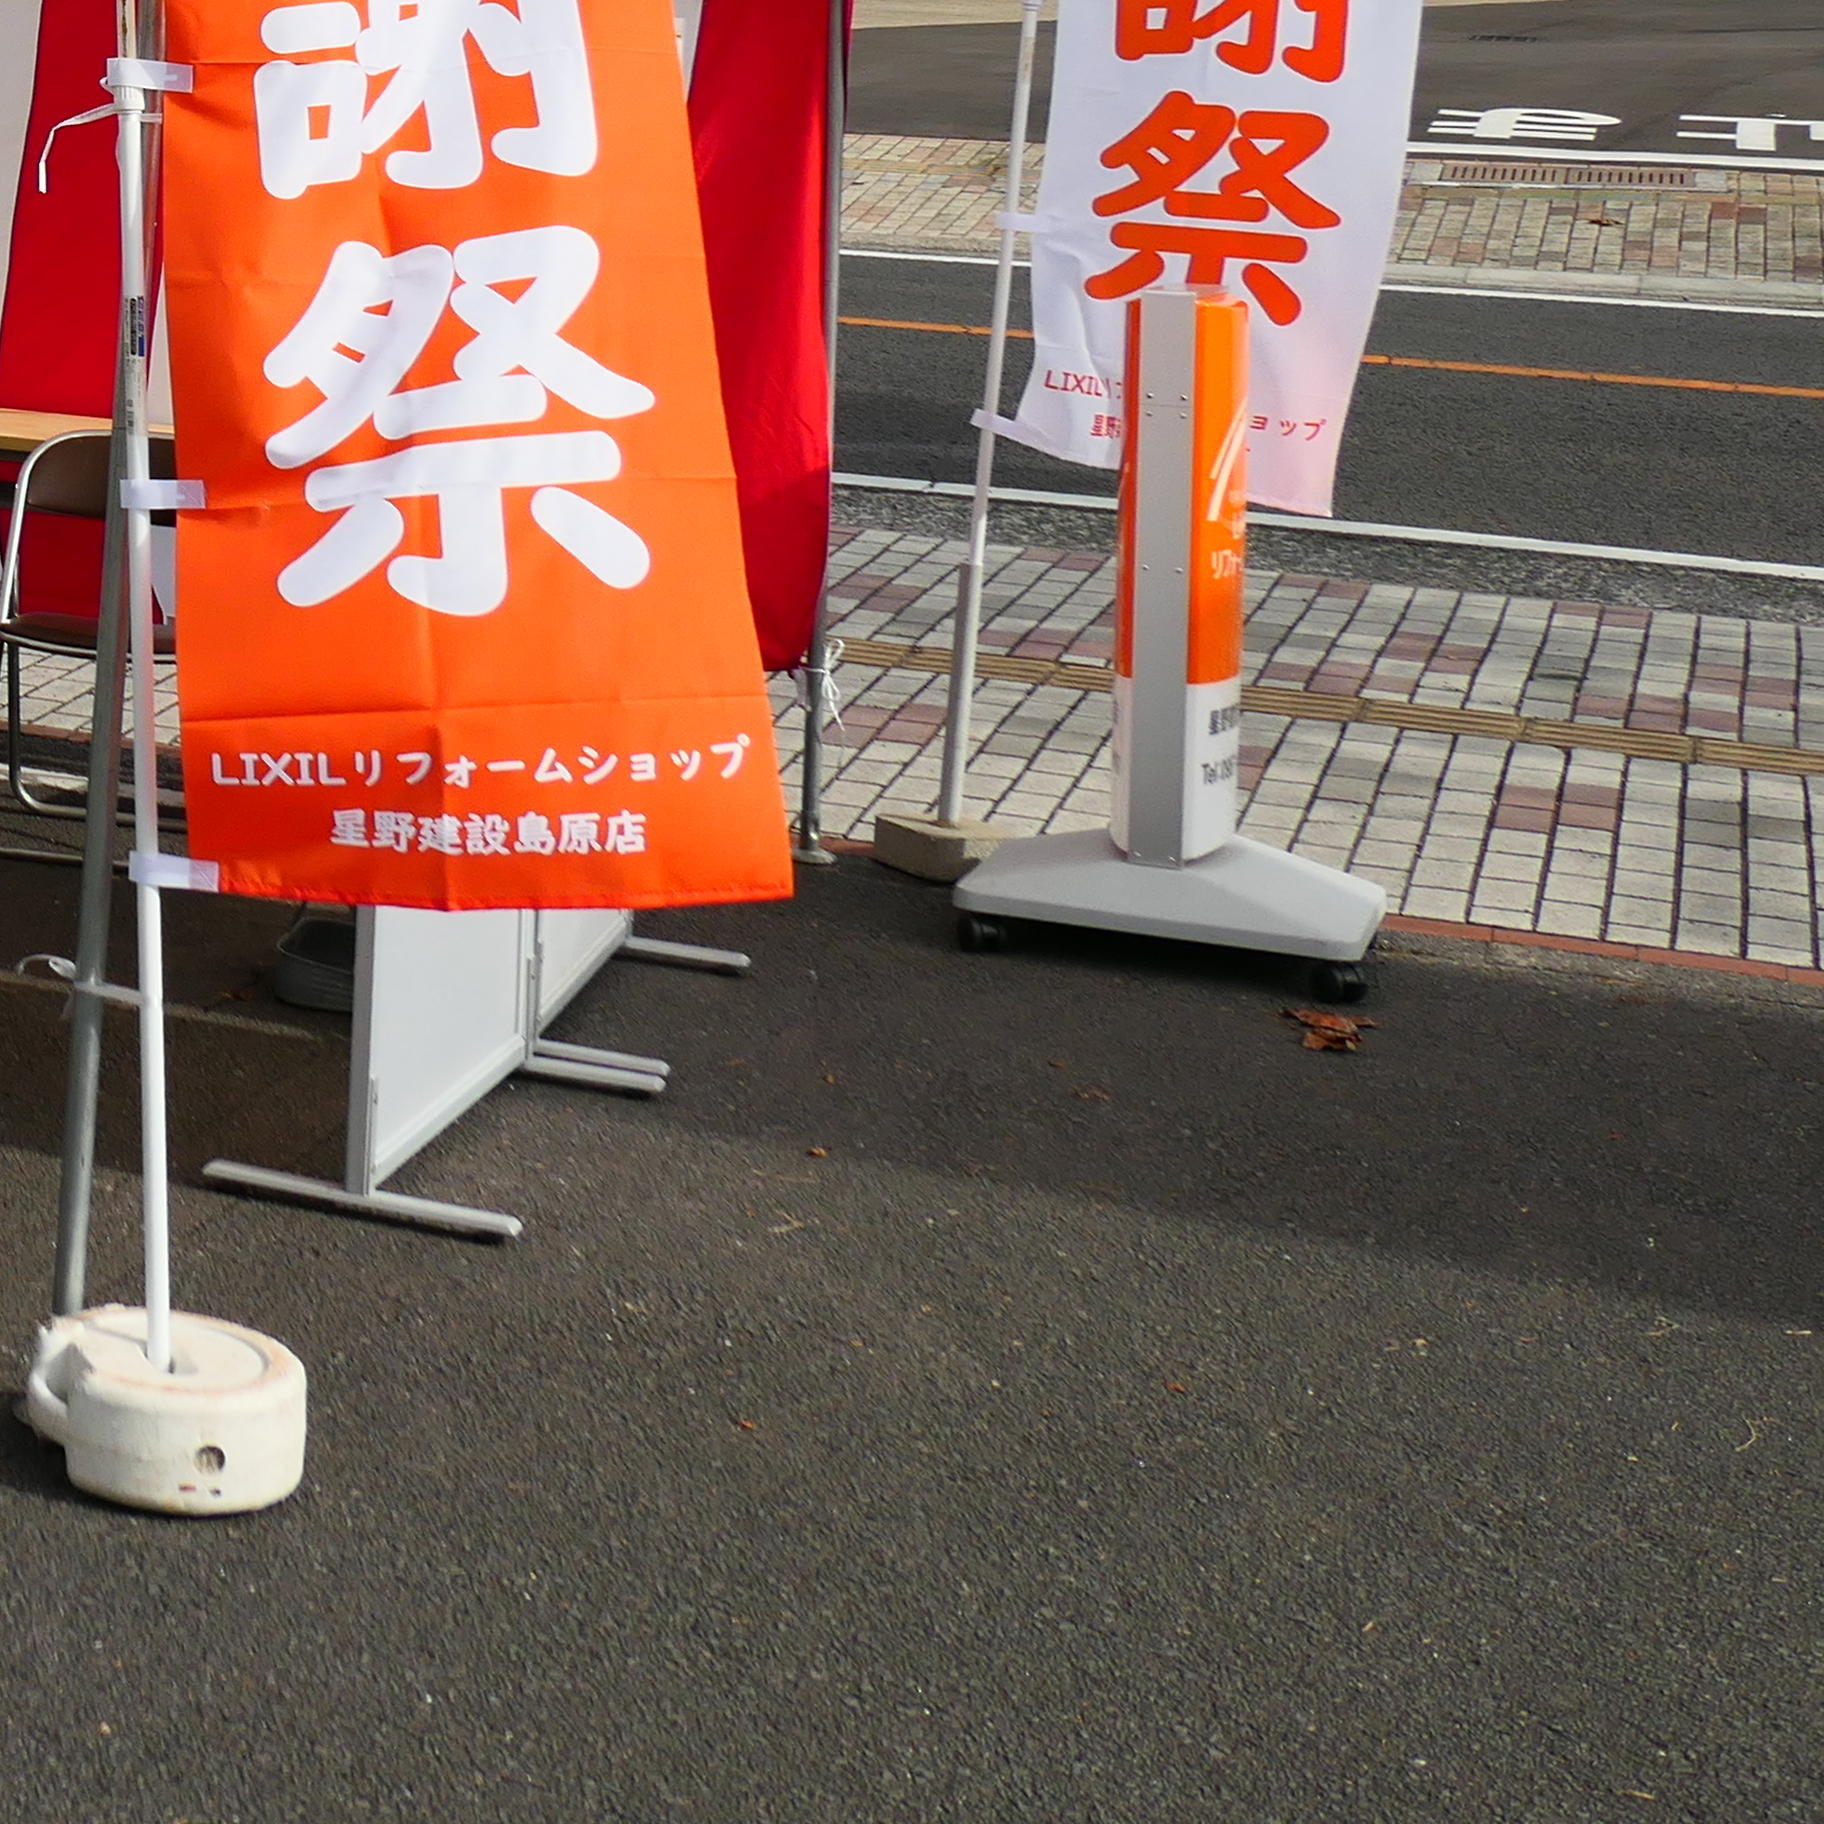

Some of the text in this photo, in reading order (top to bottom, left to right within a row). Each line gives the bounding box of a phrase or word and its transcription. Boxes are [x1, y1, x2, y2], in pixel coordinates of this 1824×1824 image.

[211, 733, 751, 786] LIXILリフォームショップ
[330, 807, 648, 857] 星野建設島原店
